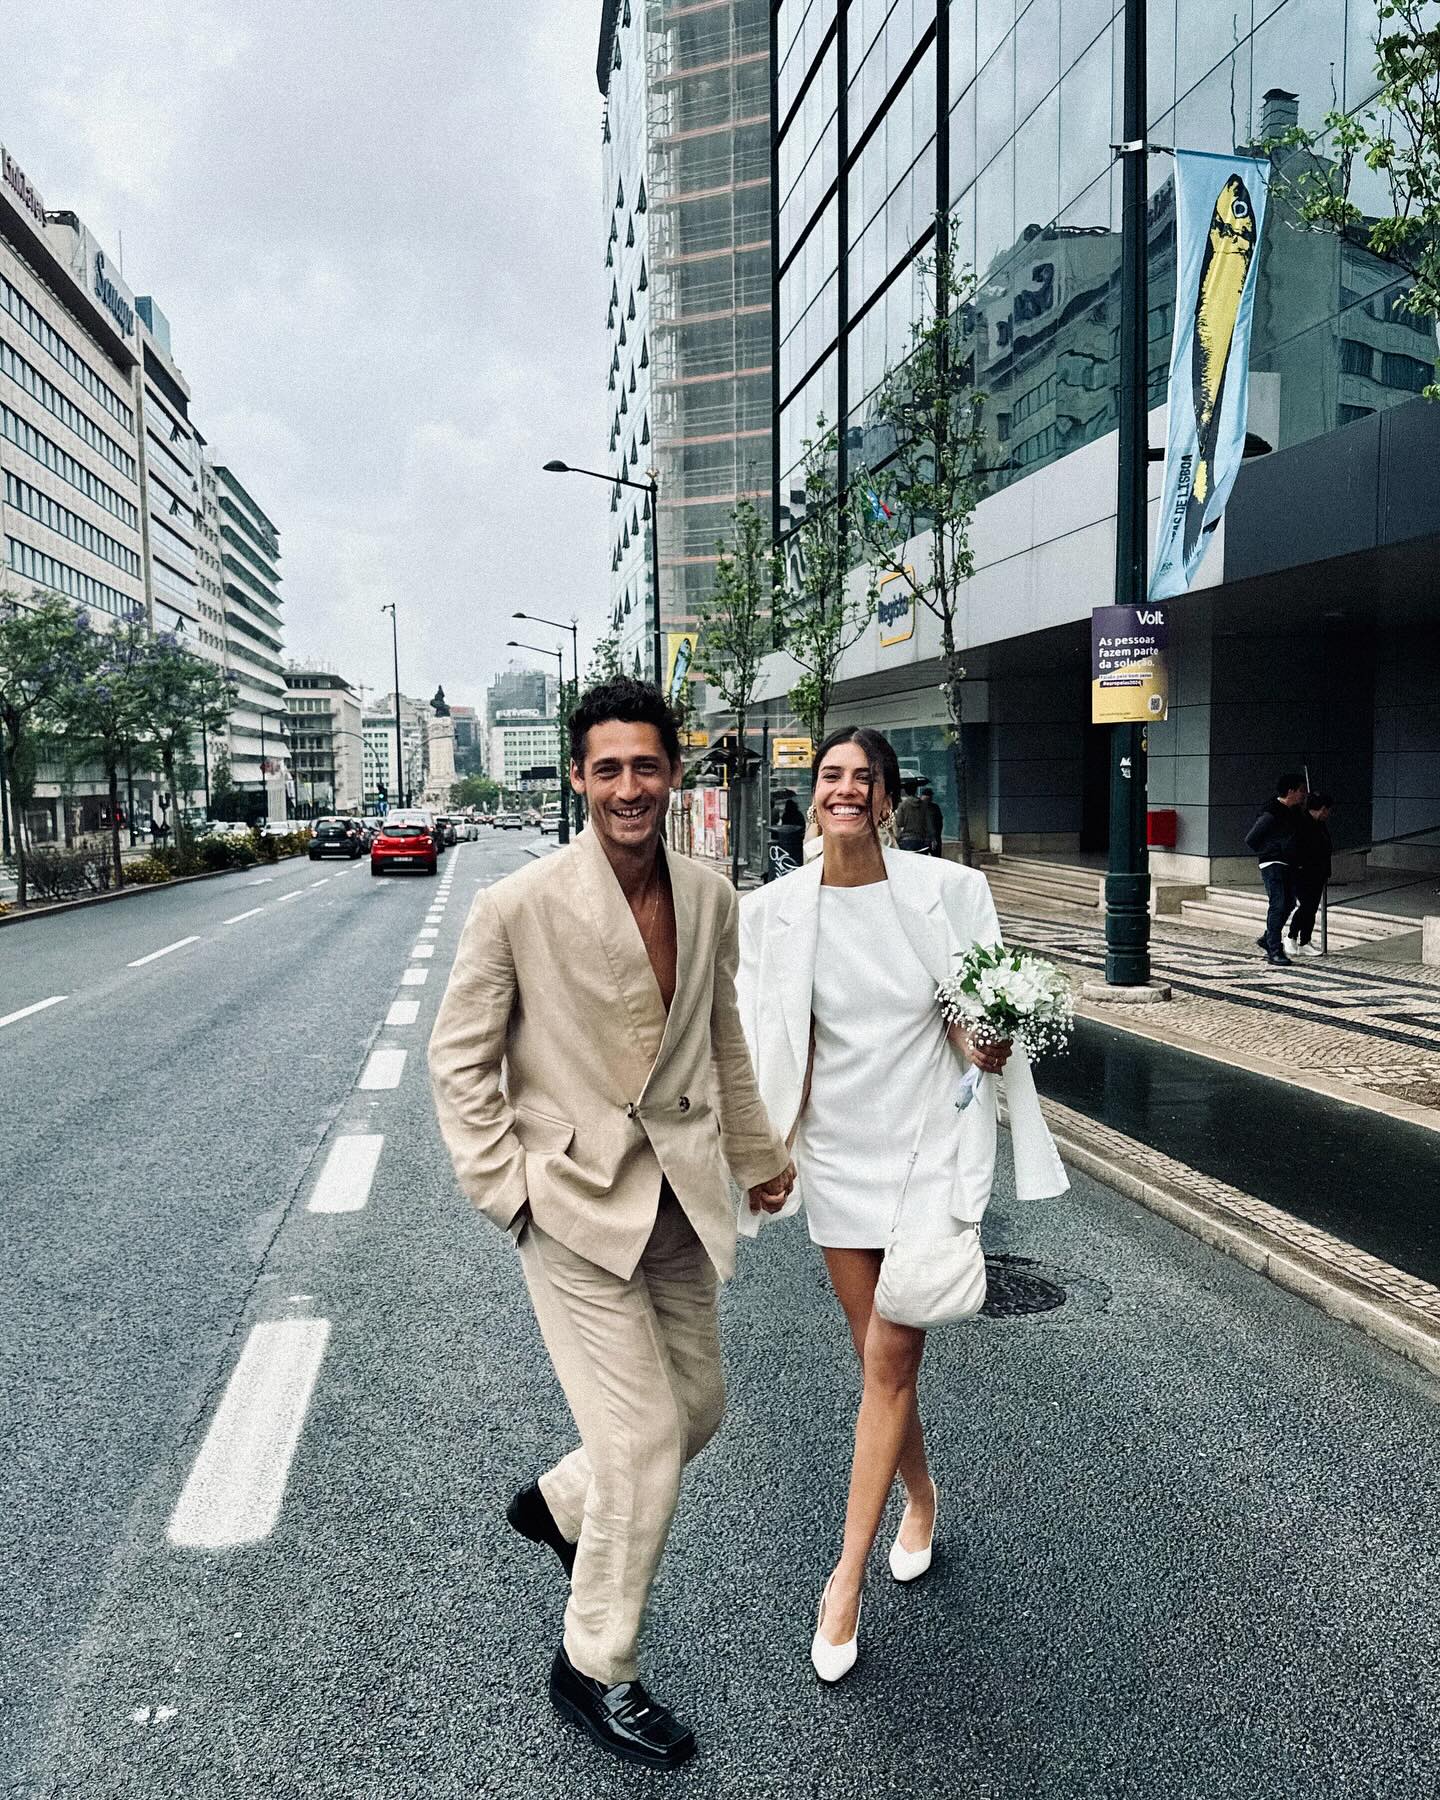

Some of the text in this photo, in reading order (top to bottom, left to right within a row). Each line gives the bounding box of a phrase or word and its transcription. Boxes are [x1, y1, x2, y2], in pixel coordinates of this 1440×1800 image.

[1177, 454, 1193, 498] LISBOA
[1175, 499, 1187, 514] DE
[1136, 610, 1164, 625] Volt
[1099, 636, 1155, 647] As pessoas
[1099, 647, 1159, 658] fazem parte
[1099, 658, 1155, 669] da solução.
